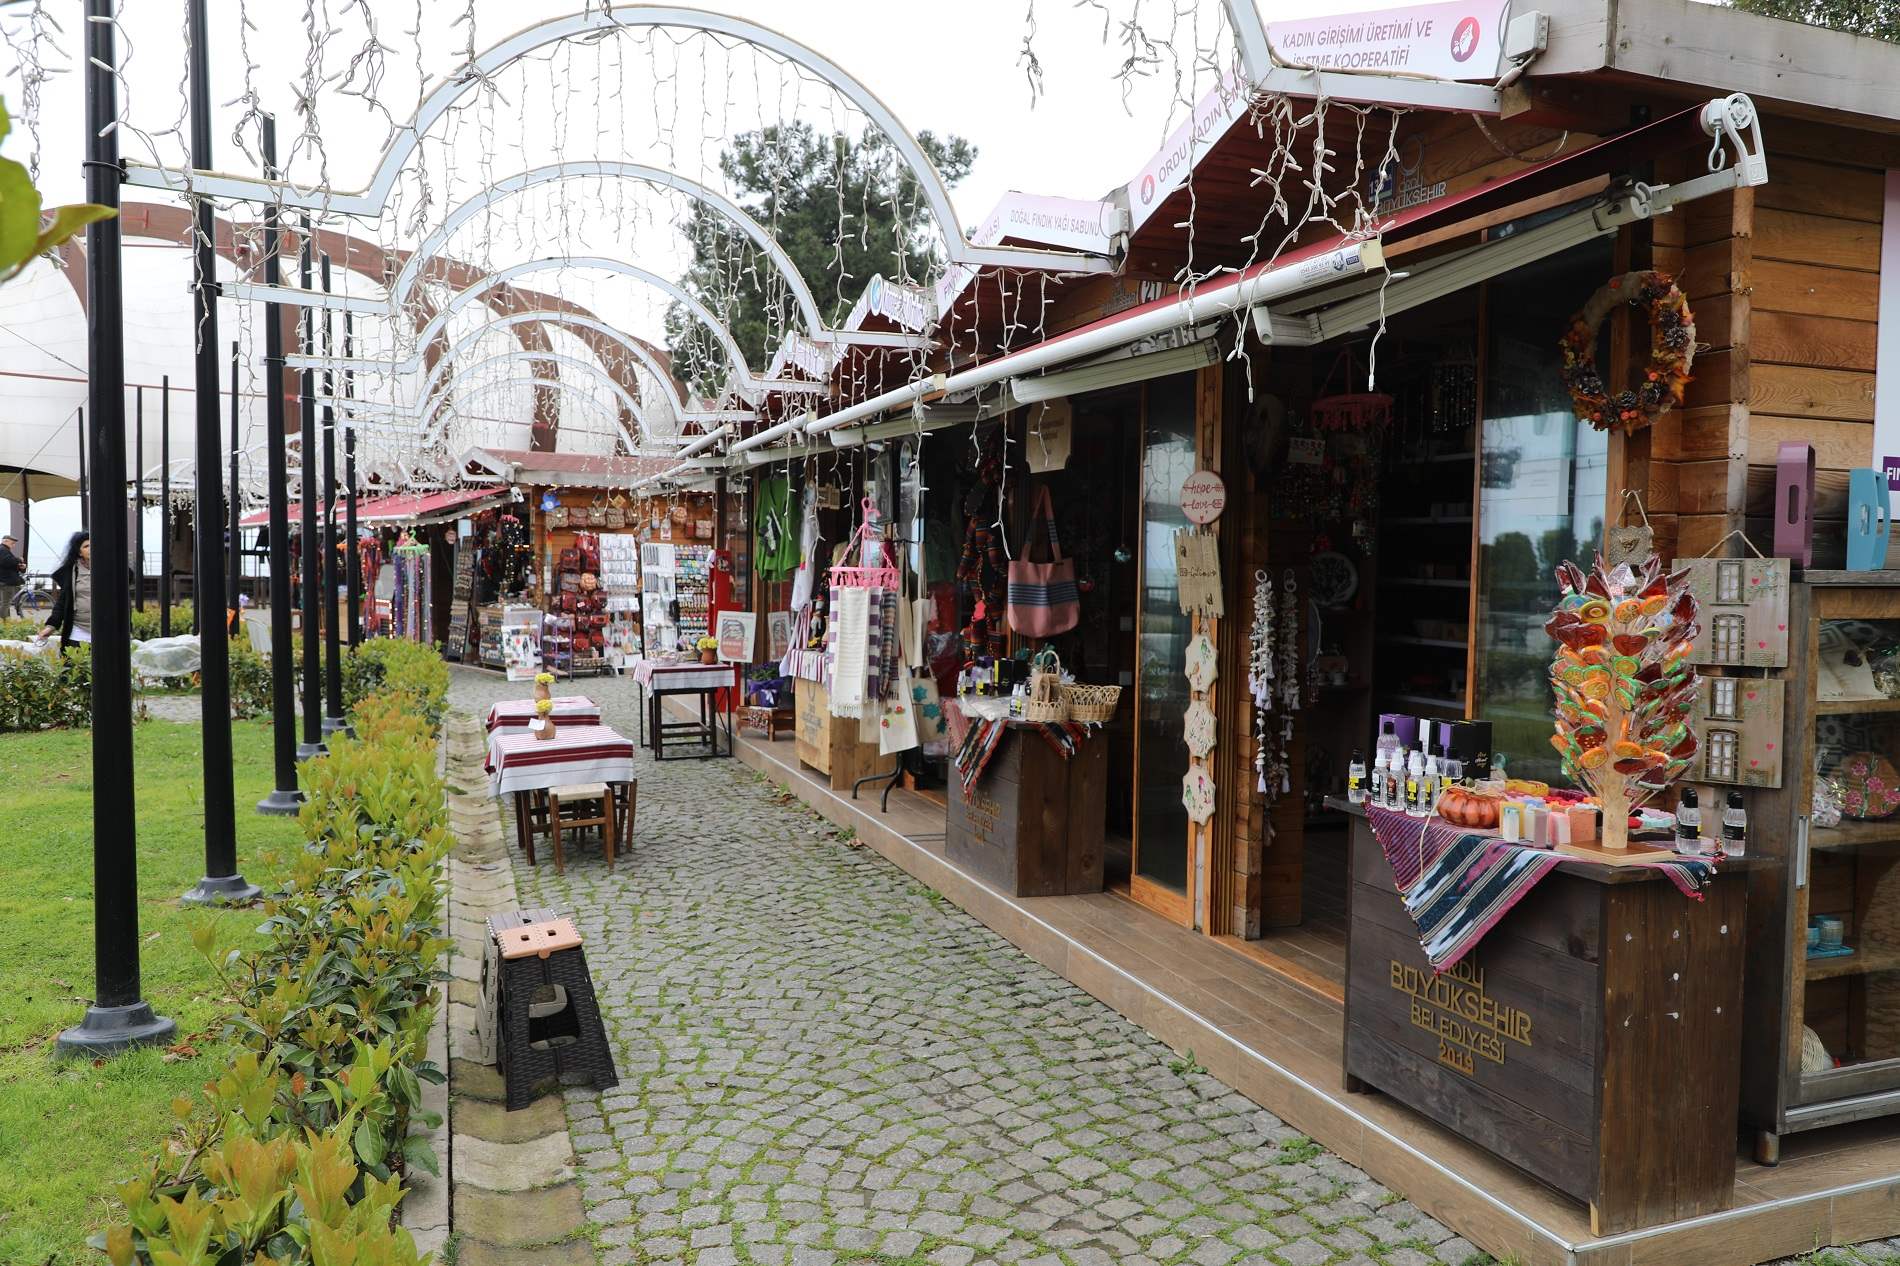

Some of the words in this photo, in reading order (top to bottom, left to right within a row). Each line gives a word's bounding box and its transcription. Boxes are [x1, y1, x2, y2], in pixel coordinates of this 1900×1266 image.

[1282, 31, 1315, 49] KADIN
[1317, 24, 1364, 48] GİRİŞİMİ
[1366, 18, 1413, 42] ÜRETİMİ
[1416, 20, 1433, 38] VE
[1333, 45, 1410, 68] KOOPERATİFİ
[1158, 143, 1187, 183] ORDU
[1070, 219, 1101, 236] SABUNU
[1446, 948, 1484, 988] RDU
[1391, 960, 1532, 1046] BÜYÜKŞEHİR
[1439, 1042, 1475, 1076] 2019
